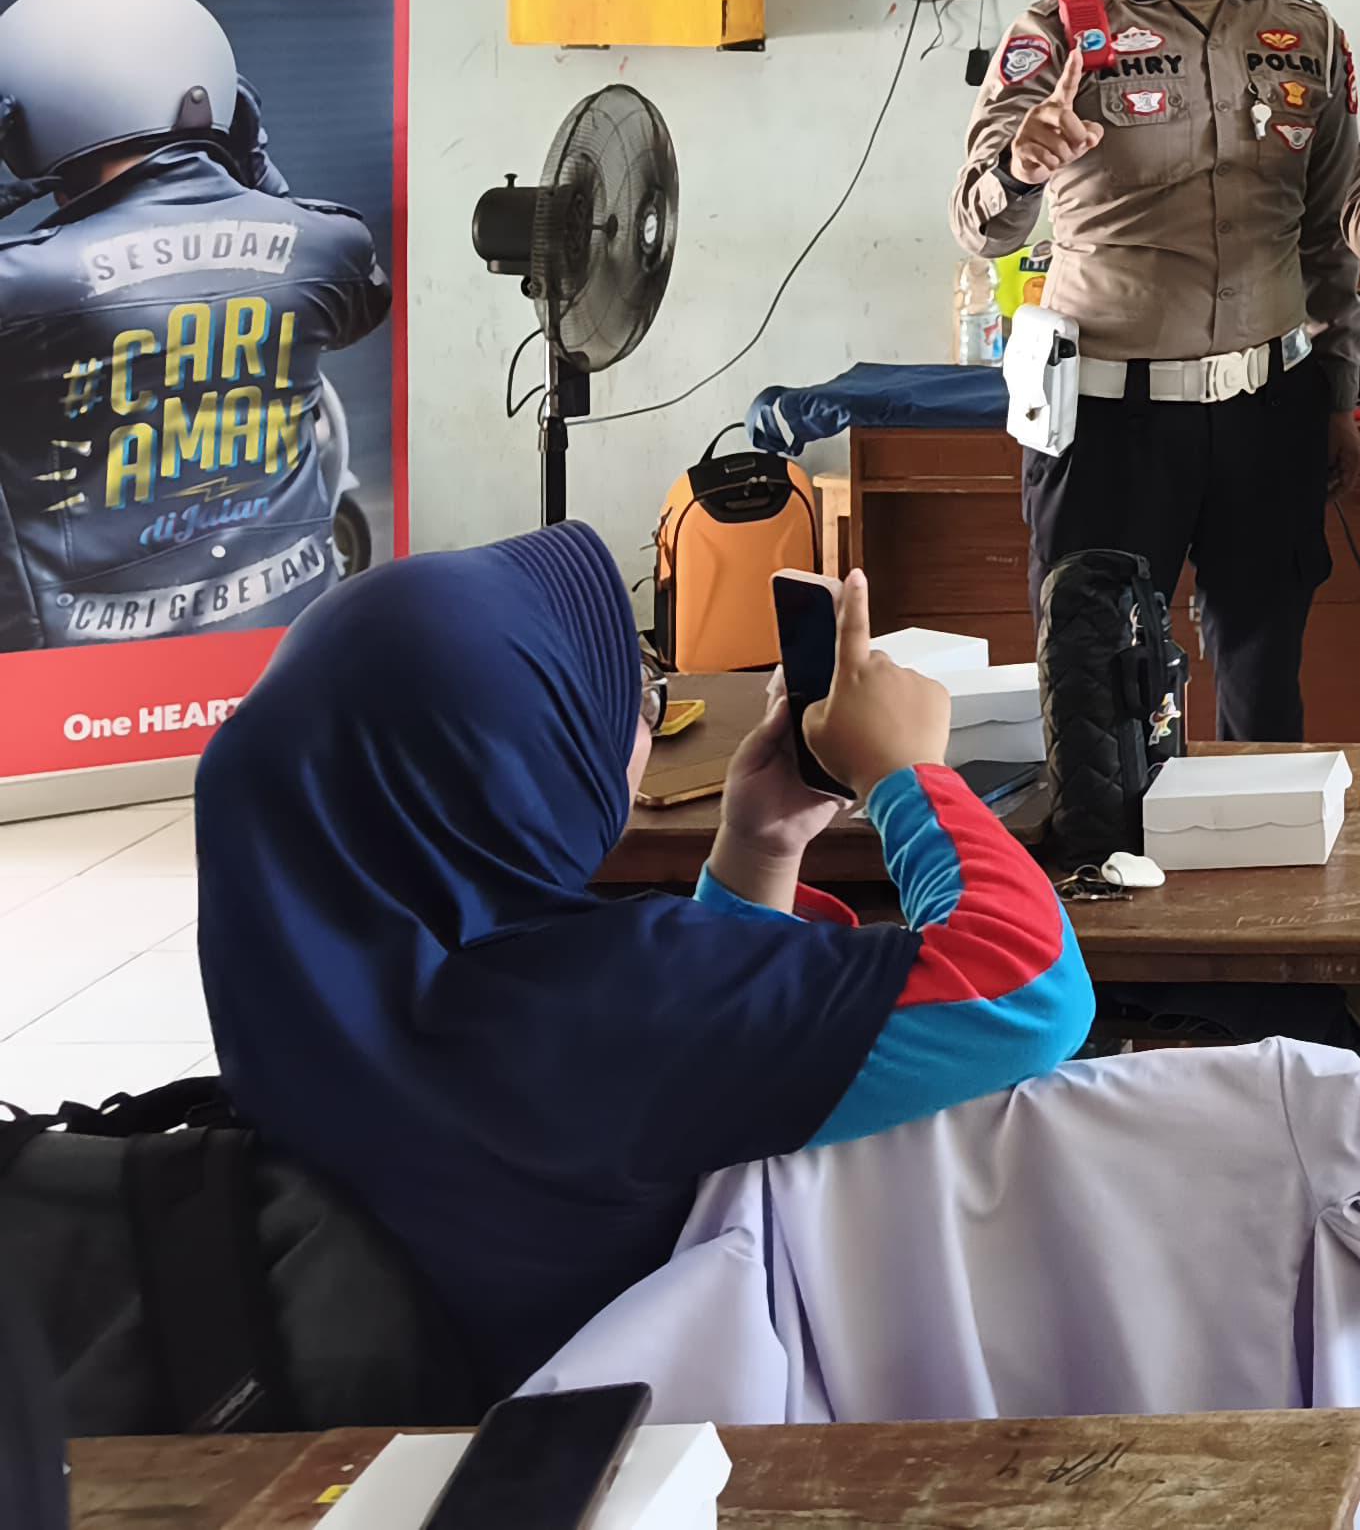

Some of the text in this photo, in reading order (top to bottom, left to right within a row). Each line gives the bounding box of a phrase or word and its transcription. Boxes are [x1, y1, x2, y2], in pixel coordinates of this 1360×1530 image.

[1248, 52, 1321, 77] POLRI
[92, 231, 292, 282] SESUDAH
[62, 296, 296, 419] #CARI
[105, 385, 304, 509] AMAN
[75, 544, 321, 632] CARI GEBETAN
[63, 713, 132, 741] One
